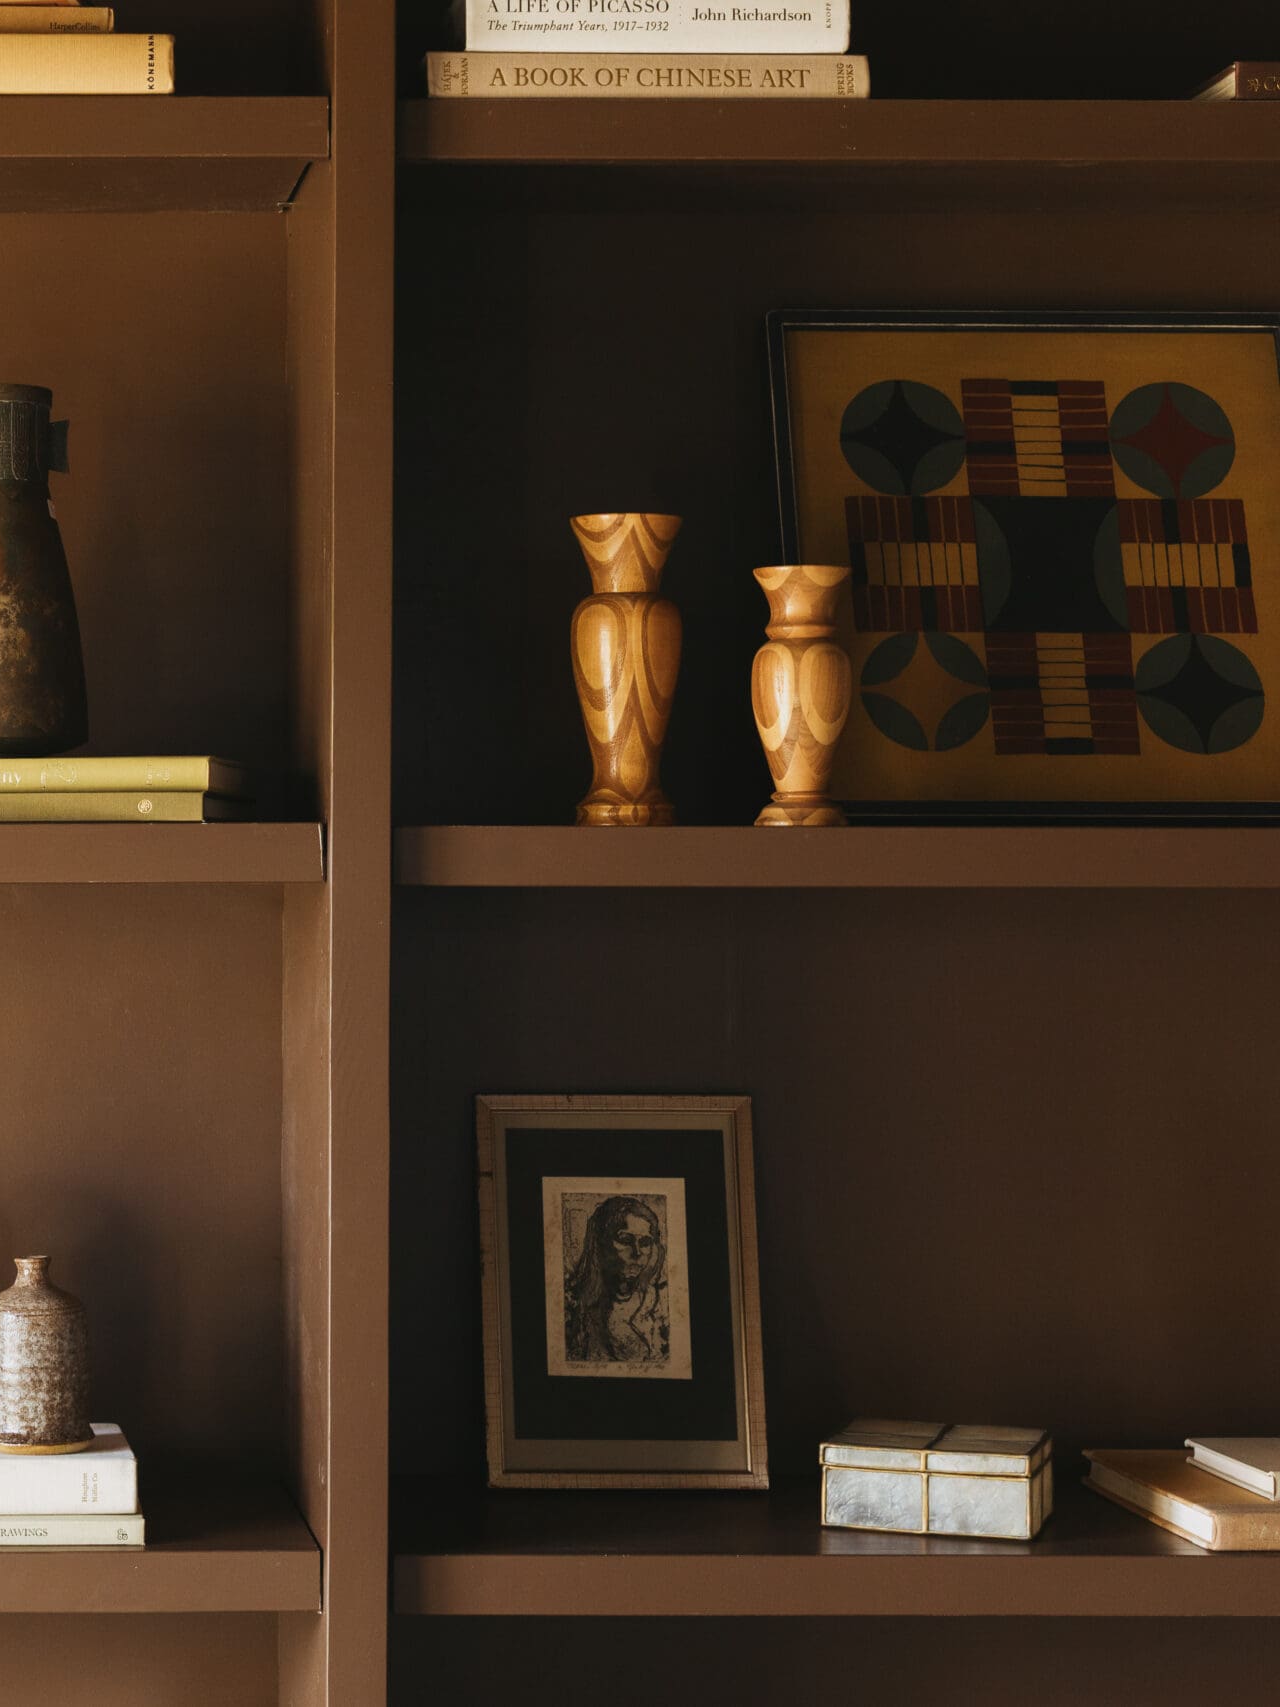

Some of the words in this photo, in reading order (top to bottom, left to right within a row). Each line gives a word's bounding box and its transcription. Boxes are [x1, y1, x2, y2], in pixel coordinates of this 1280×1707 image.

[487, 0, 499, 13] A
[506, 0, 550, 13] LIFE
[556, 0, 582, 13] OF
[588, 0, 670, 14] PICASSO
[692, 8, 728, 22] John
[731, 8, 812, 22] Richardson
[487, 20, 508, 31] The
[510, 20, 575, 34] Triumphant
[578, 20, 608, 34] Years,
[489, 69, 507, 87] A
[513, 68, 587, 88] BOOK
[594, 69, 629, 88] OF
[636, 69, 752, 89] CHINESE
[759, 69, 811, 89] ART
[836, 62, 846, 96] SPRING
